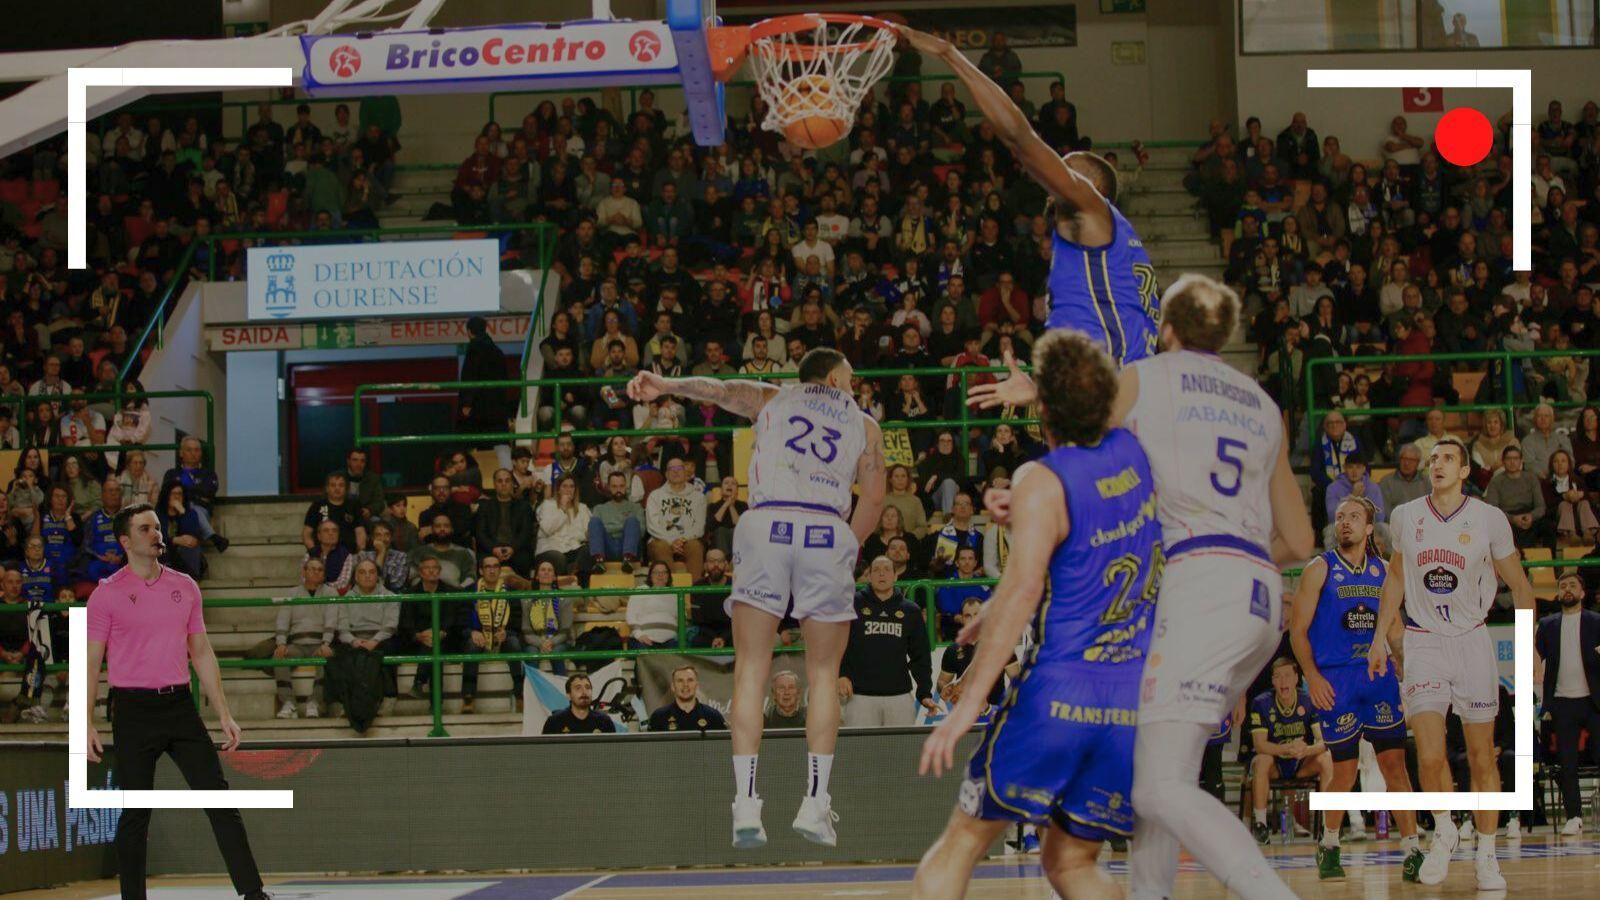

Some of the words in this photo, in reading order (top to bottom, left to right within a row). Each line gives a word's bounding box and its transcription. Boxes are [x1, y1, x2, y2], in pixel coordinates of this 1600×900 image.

[386, 37, 606, 70] BricoCentro
[314, 251, 485, 283] DEPUTACIÓN
[314, 285, 439, 309] OURENSE
[222, 327, 290, 345] SAIDA
[391, 316, 531, 339] EMERXNCIA
[1180, 372, 1262, 409] ANDERSSON
[785, 415, 842, 464] 23
[1210, 436, 1248, 497] 5
[1417, 548, 1466, 571] OBRADOIRO
[1428, 573, 1454, 582] Estrella
[1429, 581, 1453, 589] Galicia
[1347, 612, 1376, 622] Estrella
[1348, 620, 1375, 629] Galicia
[1436, 604, 1451, 624] 11
[864, 620, 903, 638] 32005
[16, 787, 59, 853] UNA
